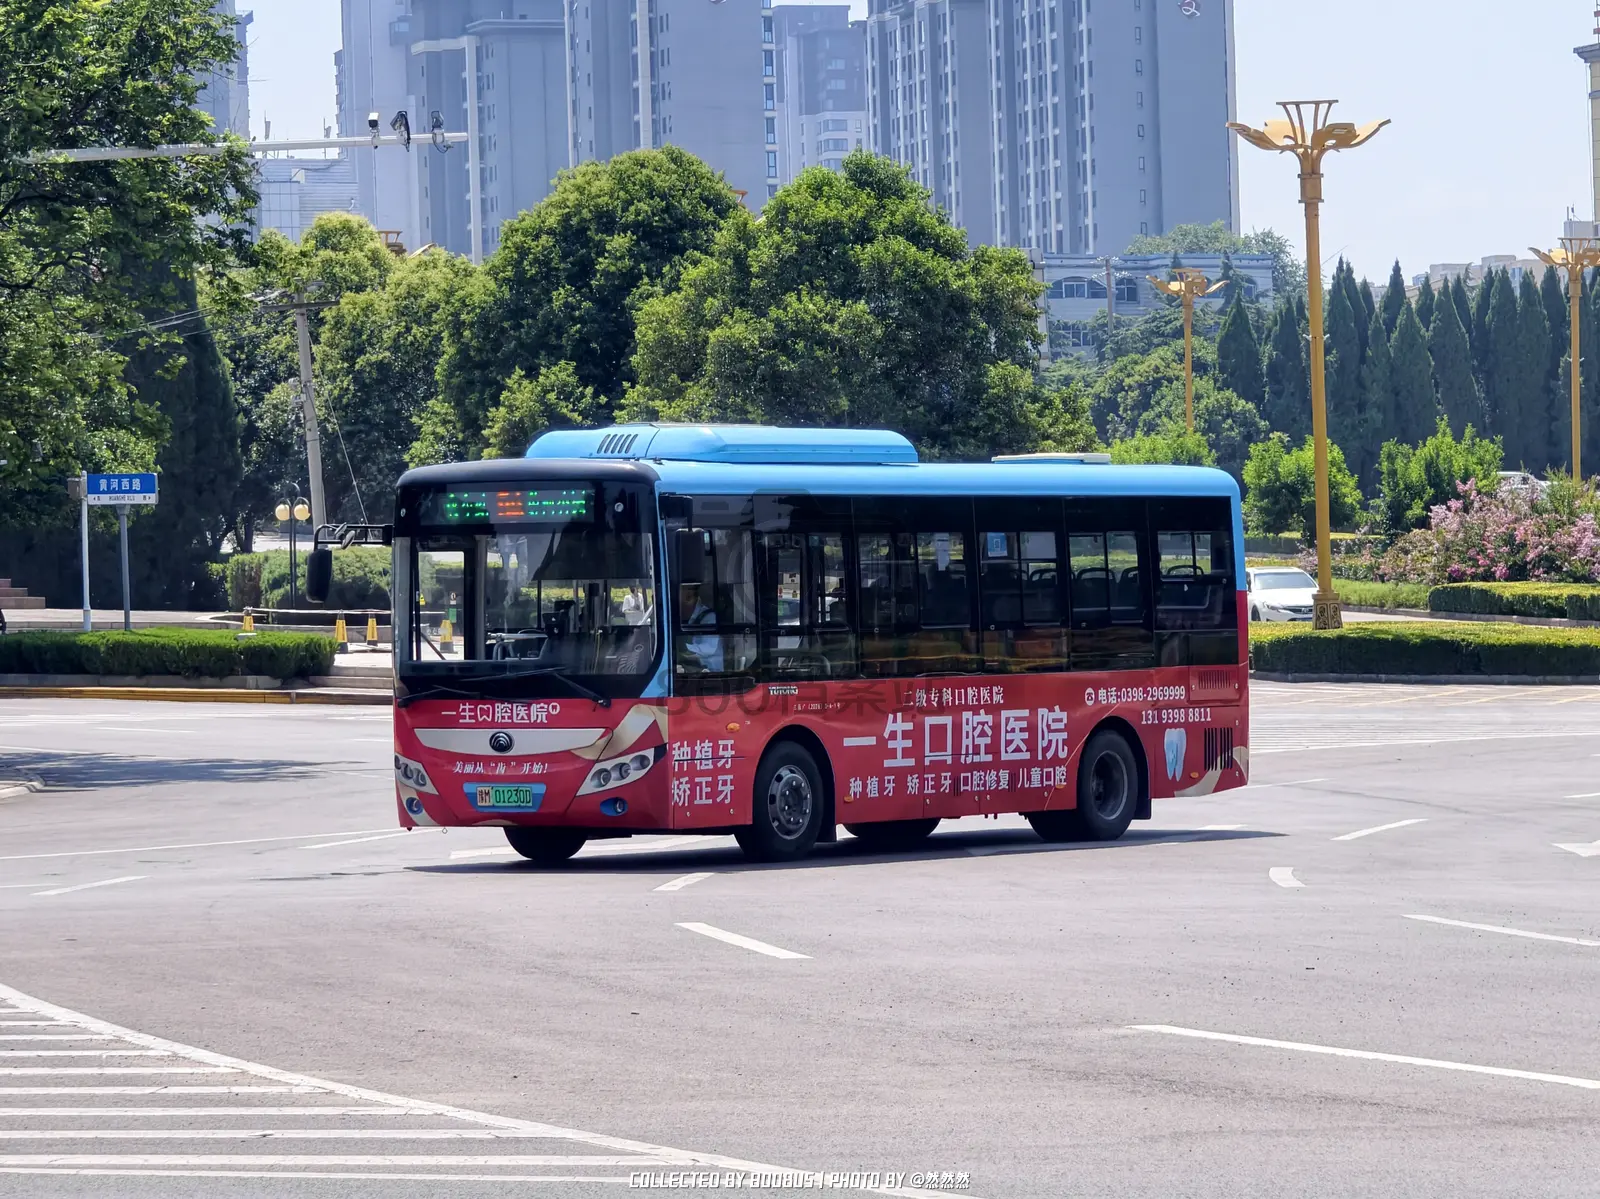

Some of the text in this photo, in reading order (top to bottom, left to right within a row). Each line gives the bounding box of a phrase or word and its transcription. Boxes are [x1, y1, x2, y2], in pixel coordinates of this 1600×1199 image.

[99, 478, 141, 491] 黄河西路
[903, 686, 1004, 707] 二级专科口腔医院
[1141, 707, 1212, 724] 131 9398 8811
[843, 705, 1068, 768] 一生口腔医院
[672, 739, 735, 772] 种植牙
[672, 774, 735, 807] 矫正牙
[850, 765, 1067, 798] 种植牙 矫正牙 口腔修复 儿童口腔
